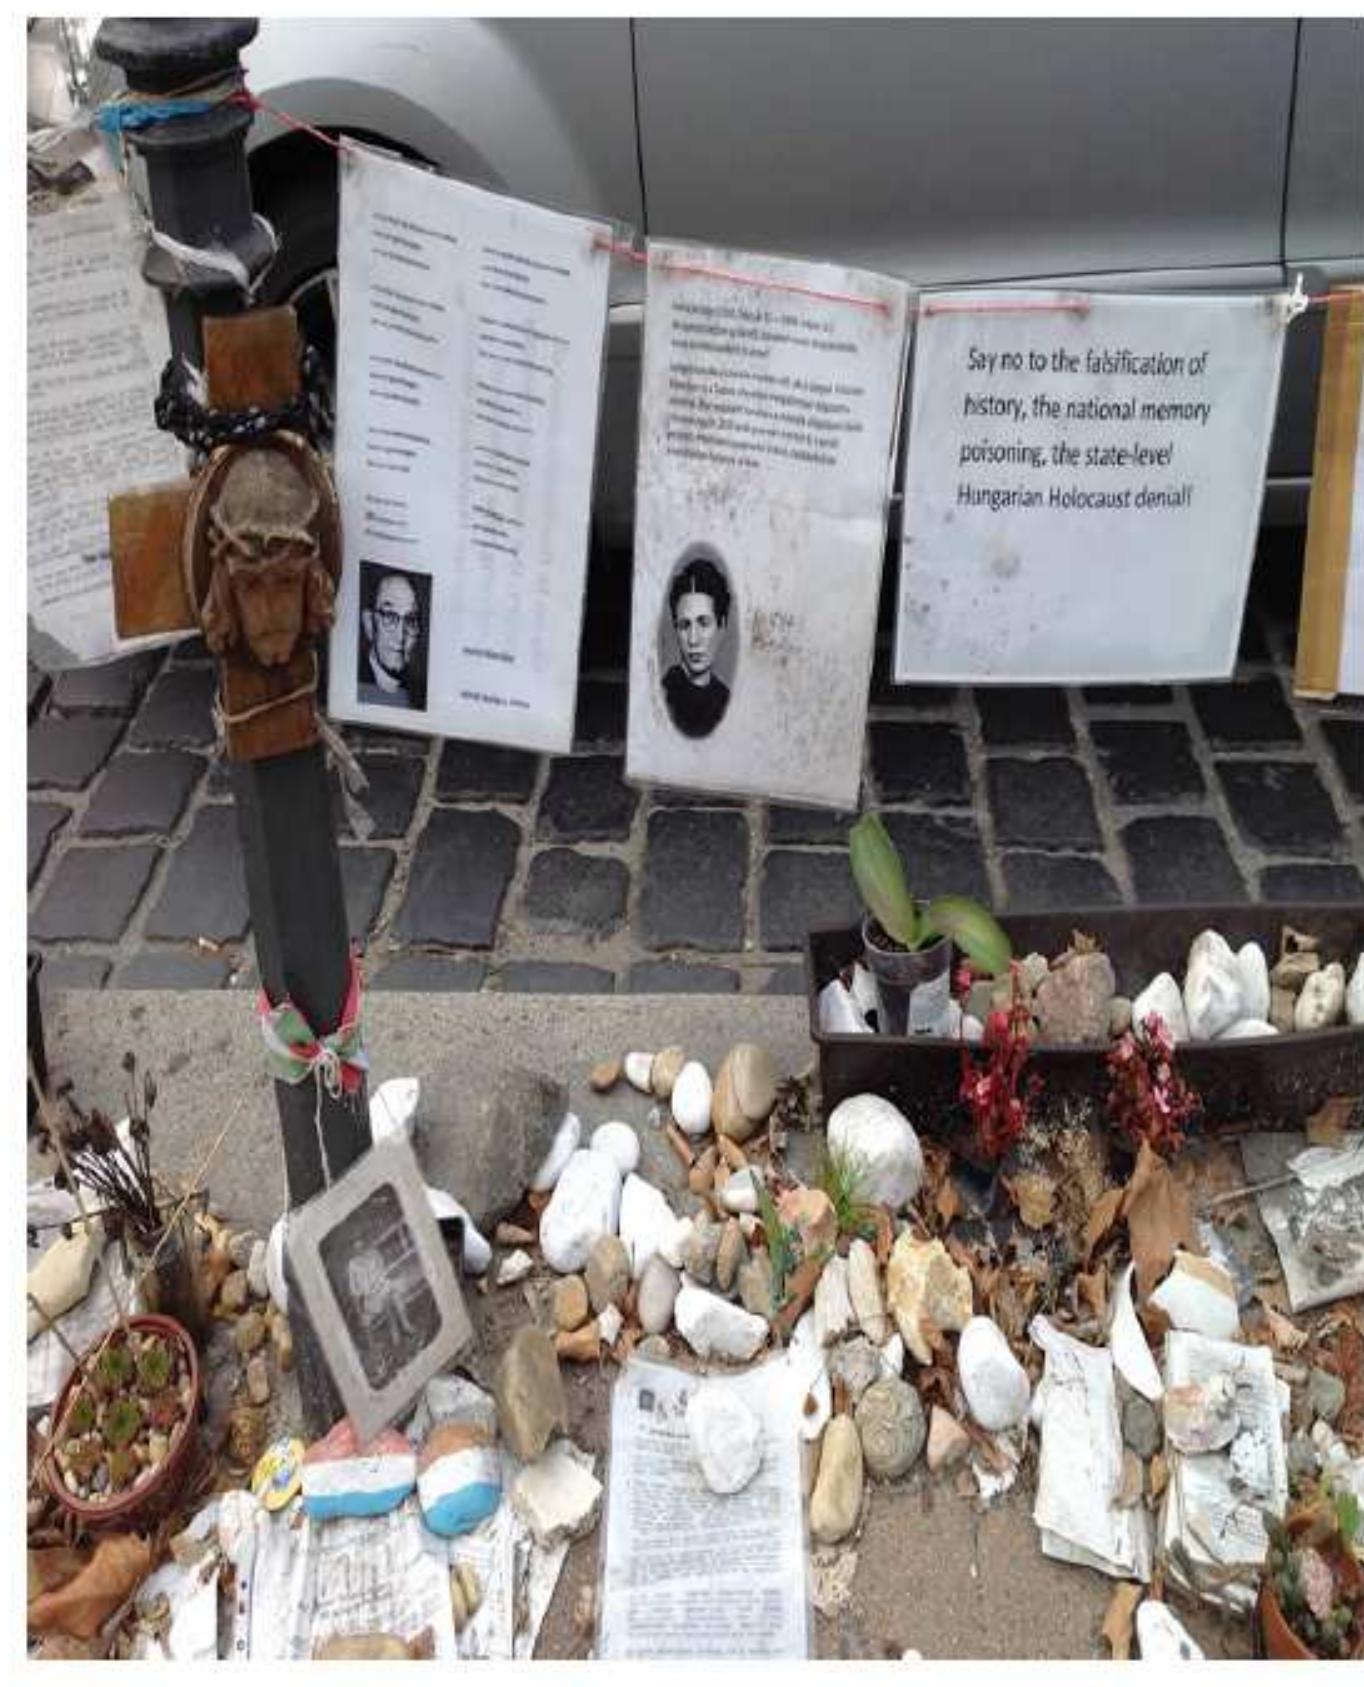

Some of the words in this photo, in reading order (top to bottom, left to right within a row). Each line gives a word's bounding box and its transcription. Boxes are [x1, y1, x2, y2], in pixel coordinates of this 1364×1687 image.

[967, 345, 996, 377] Say
[1001, 352, 1023, 371] no
[1029, 350, 1048, 371] to
[1051, 348, 1080, 373] the
[1085, 348, 1185, 376] falsification
[1188, 350, 1209, 376] of
[963, 392, 1027, 422] history,
[1032, 393, 1061, 418] the
[1066, 396, 1136, 420] national
[1141, 402, 1211, 426] memory
[959, 437, 1048, 468] poisoning,
[1052, 440, 1080, 466] the
[1085, 441, 1174, 467] state-level
[957, 483, 1043, 512] Hungarian
[1049, 484, 1132, 508] Holocaust
